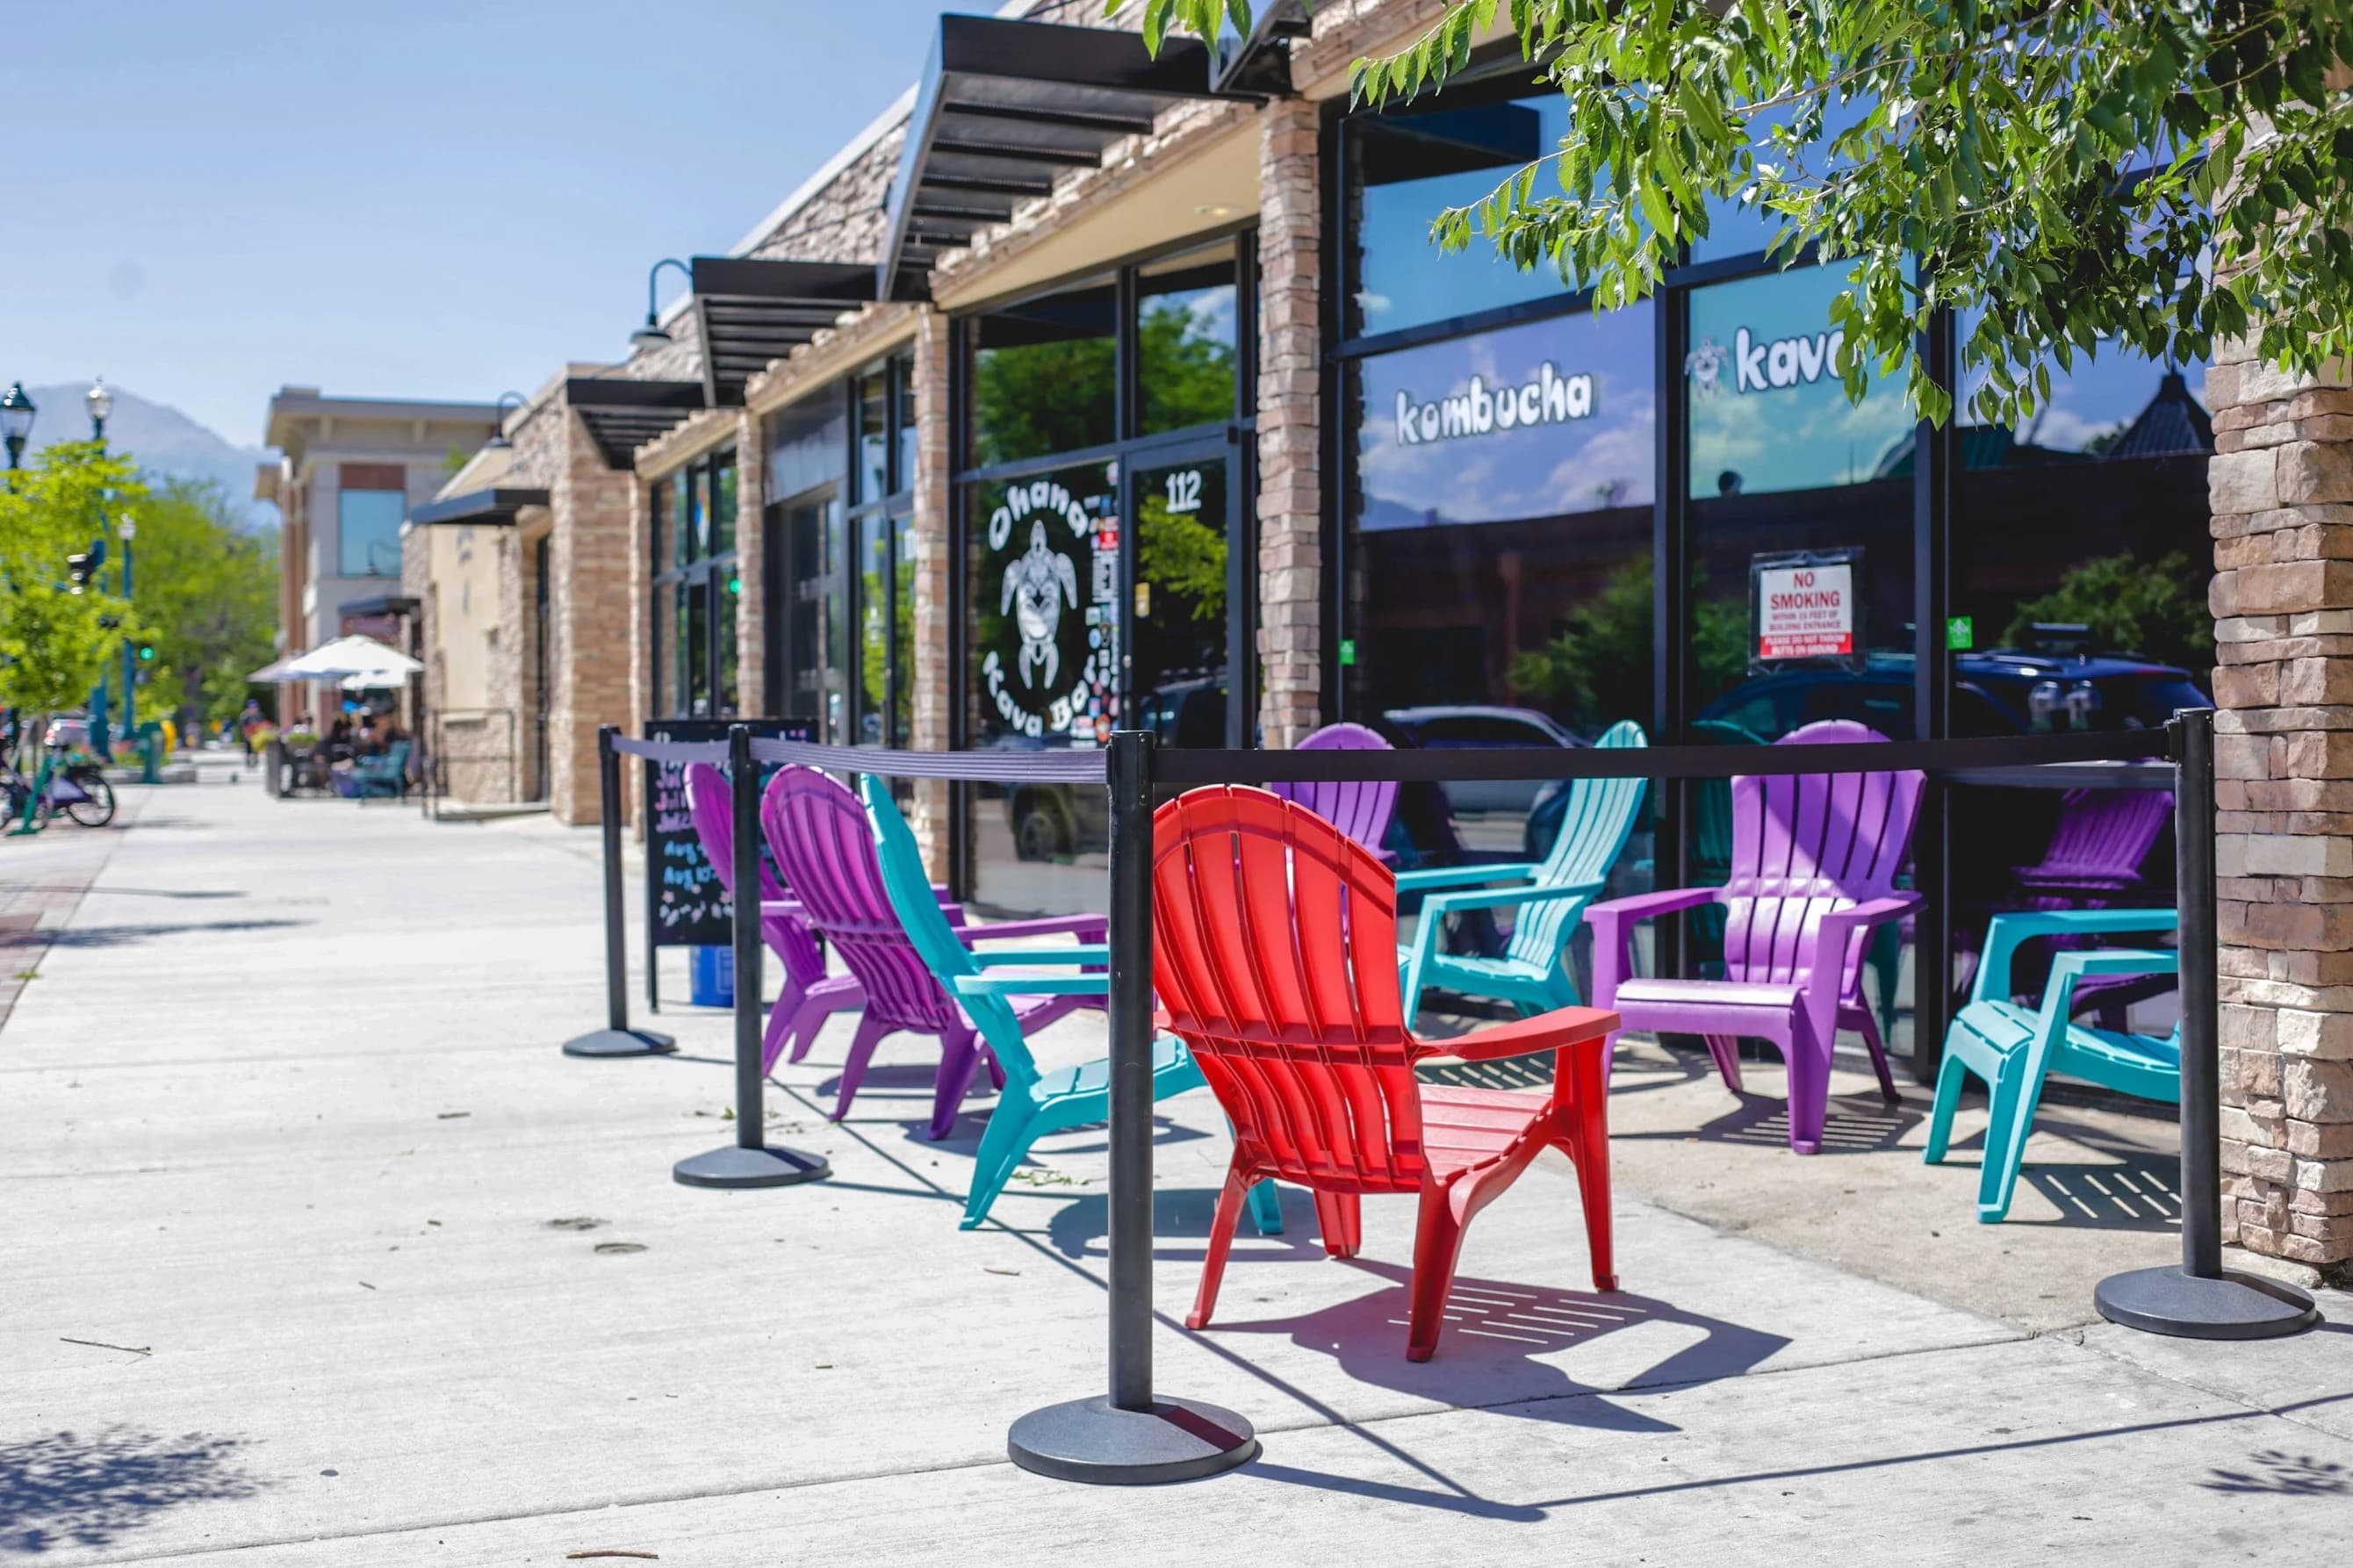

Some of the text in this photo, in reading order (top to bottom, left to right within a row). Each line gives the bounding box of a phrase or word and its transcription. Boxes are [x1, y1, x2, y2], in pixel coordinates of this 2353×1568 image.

[1395, 361, 1592, 443] kombucha
[1166, 470, 1201, 513] 112
[989, 481, 1089, 551] Ohana
[1770, 591, 1840, 609] SMOKING
[1794, 572, 1815, 588] NO
